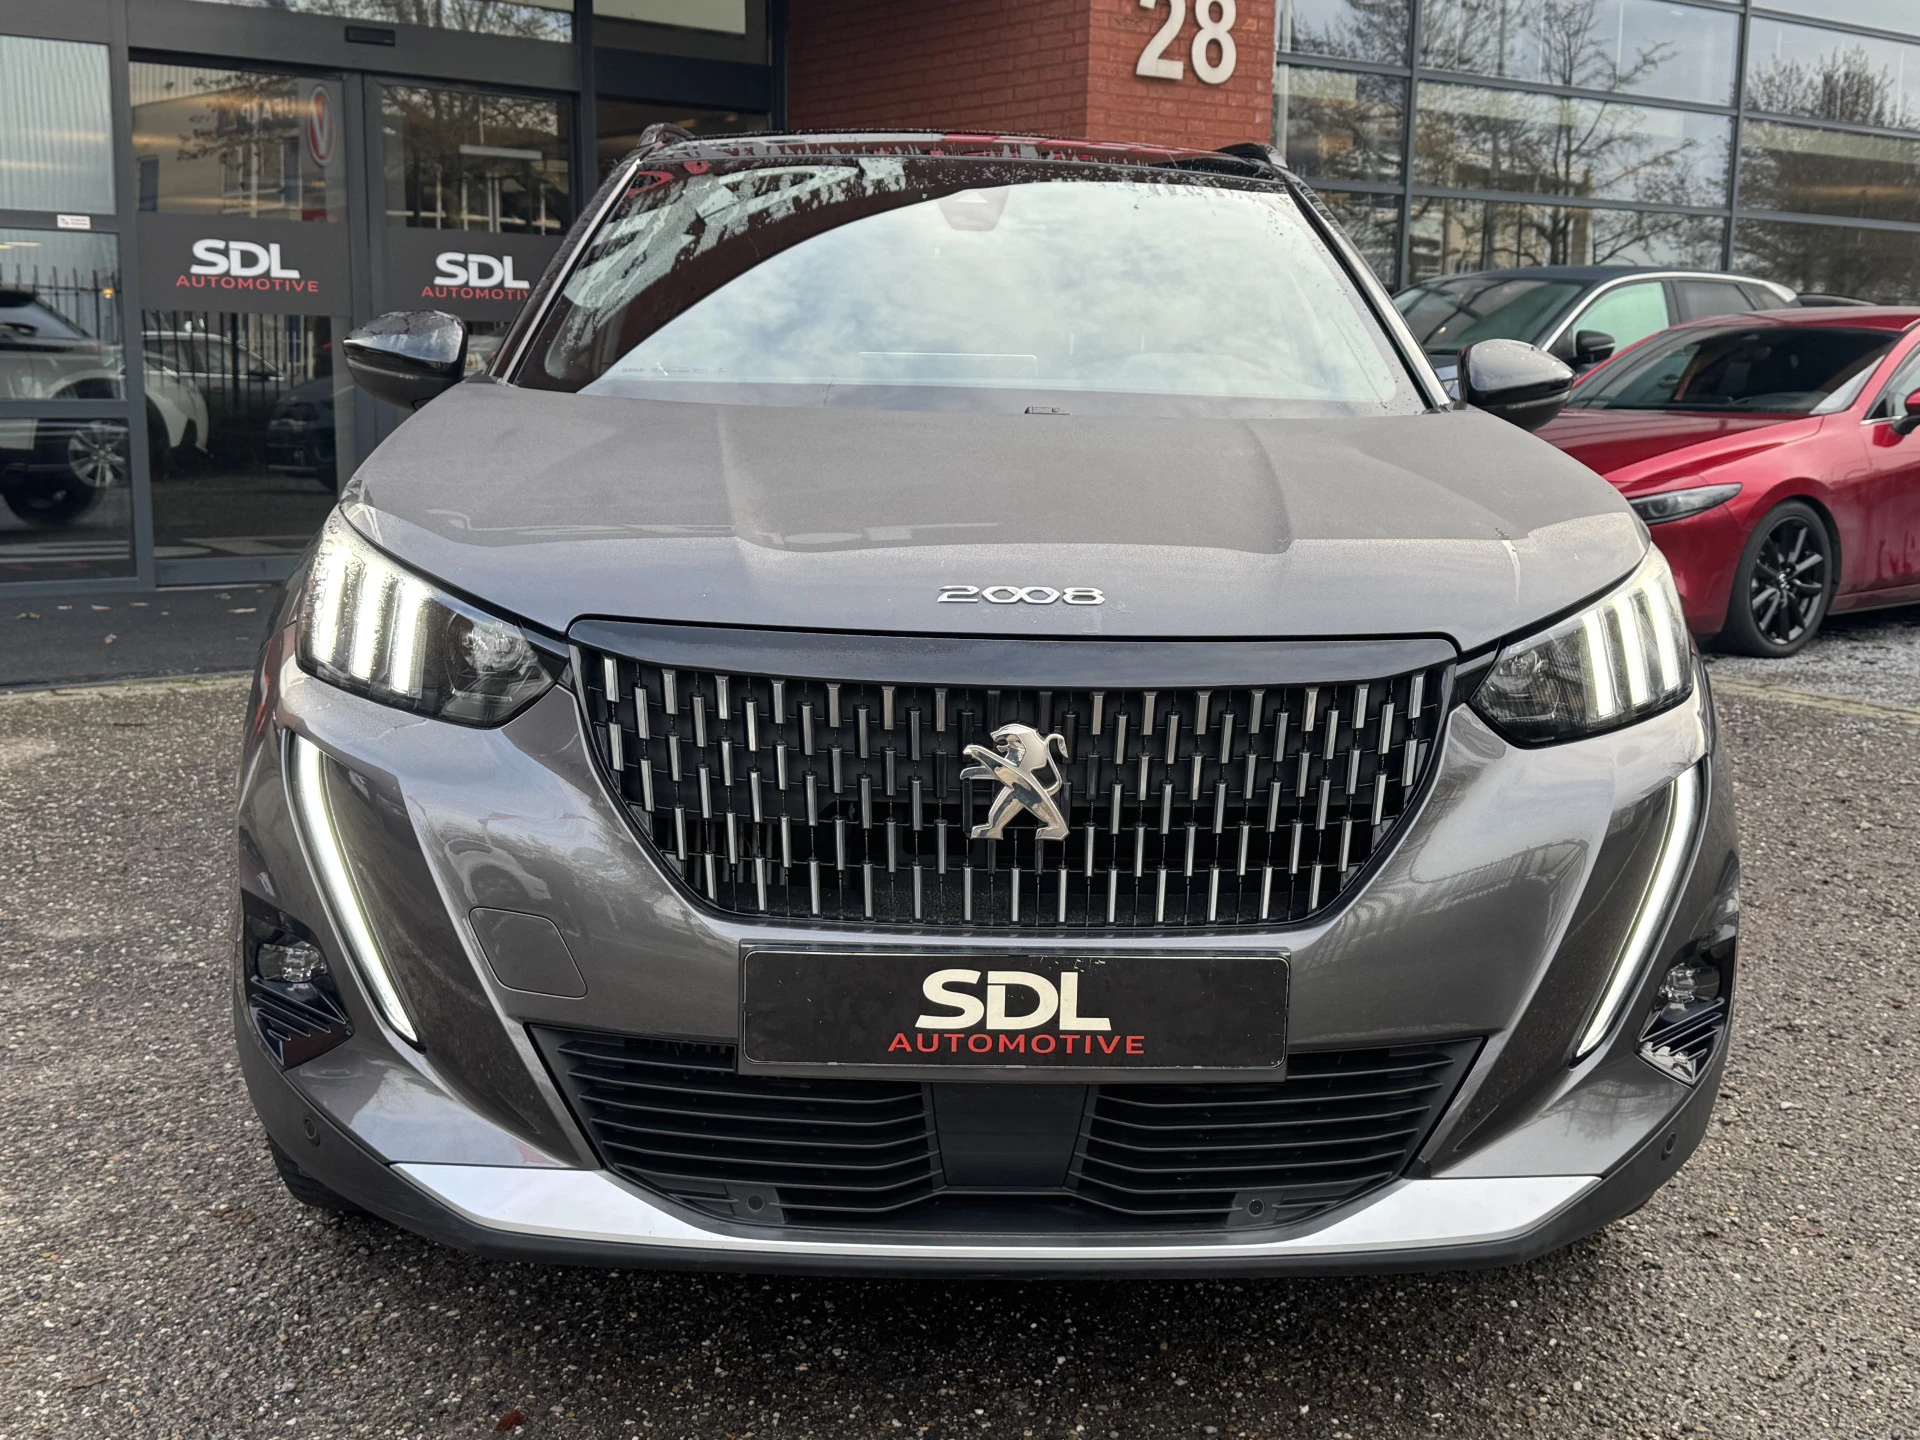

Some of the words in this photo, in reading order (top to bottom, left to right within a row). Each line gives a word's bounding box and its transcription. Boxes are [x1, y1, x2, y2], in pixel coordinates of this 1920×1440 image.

[1136, 0, 1237, 85] 28
[190, 238, 301, 279] SDL
[433, 252, 530, 289] SDL
[175, 274, 319, 293] AUTOMOTIVE
[937, 585, 1106, 605] 2008
[914, 968, 1112, 1031] SDL
[887, 1033, 1145, 1055] AUTOMOTIVE
